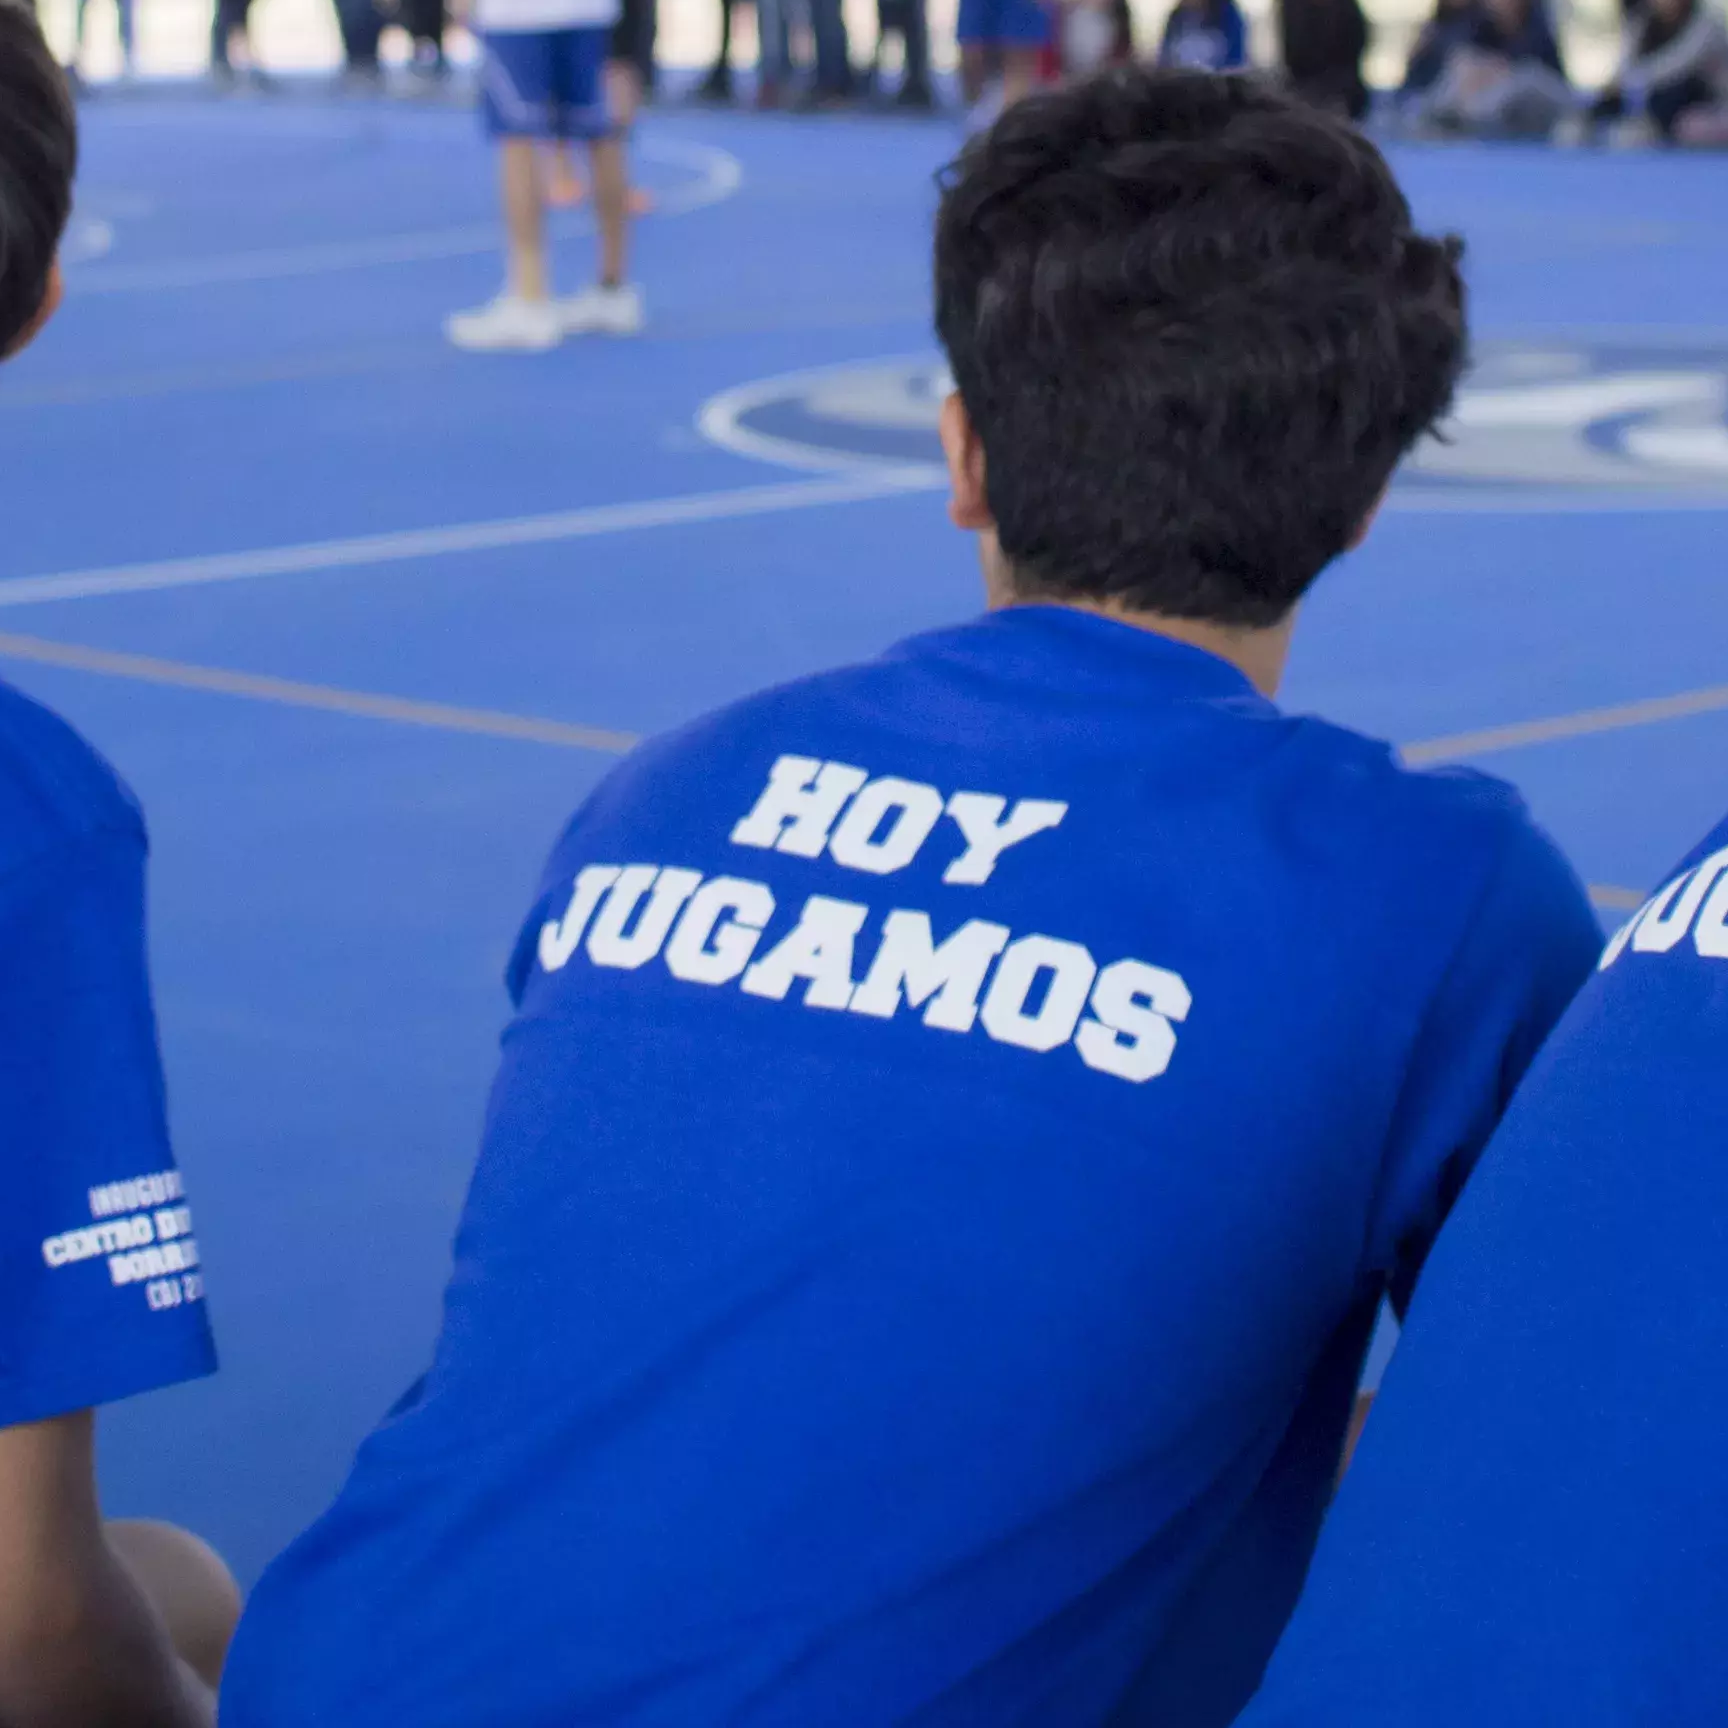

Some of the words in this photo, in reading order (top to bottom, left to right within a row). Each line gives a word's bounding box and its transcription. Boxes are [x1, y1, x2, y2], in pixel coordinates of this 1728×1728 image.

[730, 754, 1069, 886] HOY
[538, 864, 1193, 1084] JUGAMOS
[41, 1214, 155, 1268] CENTRO
